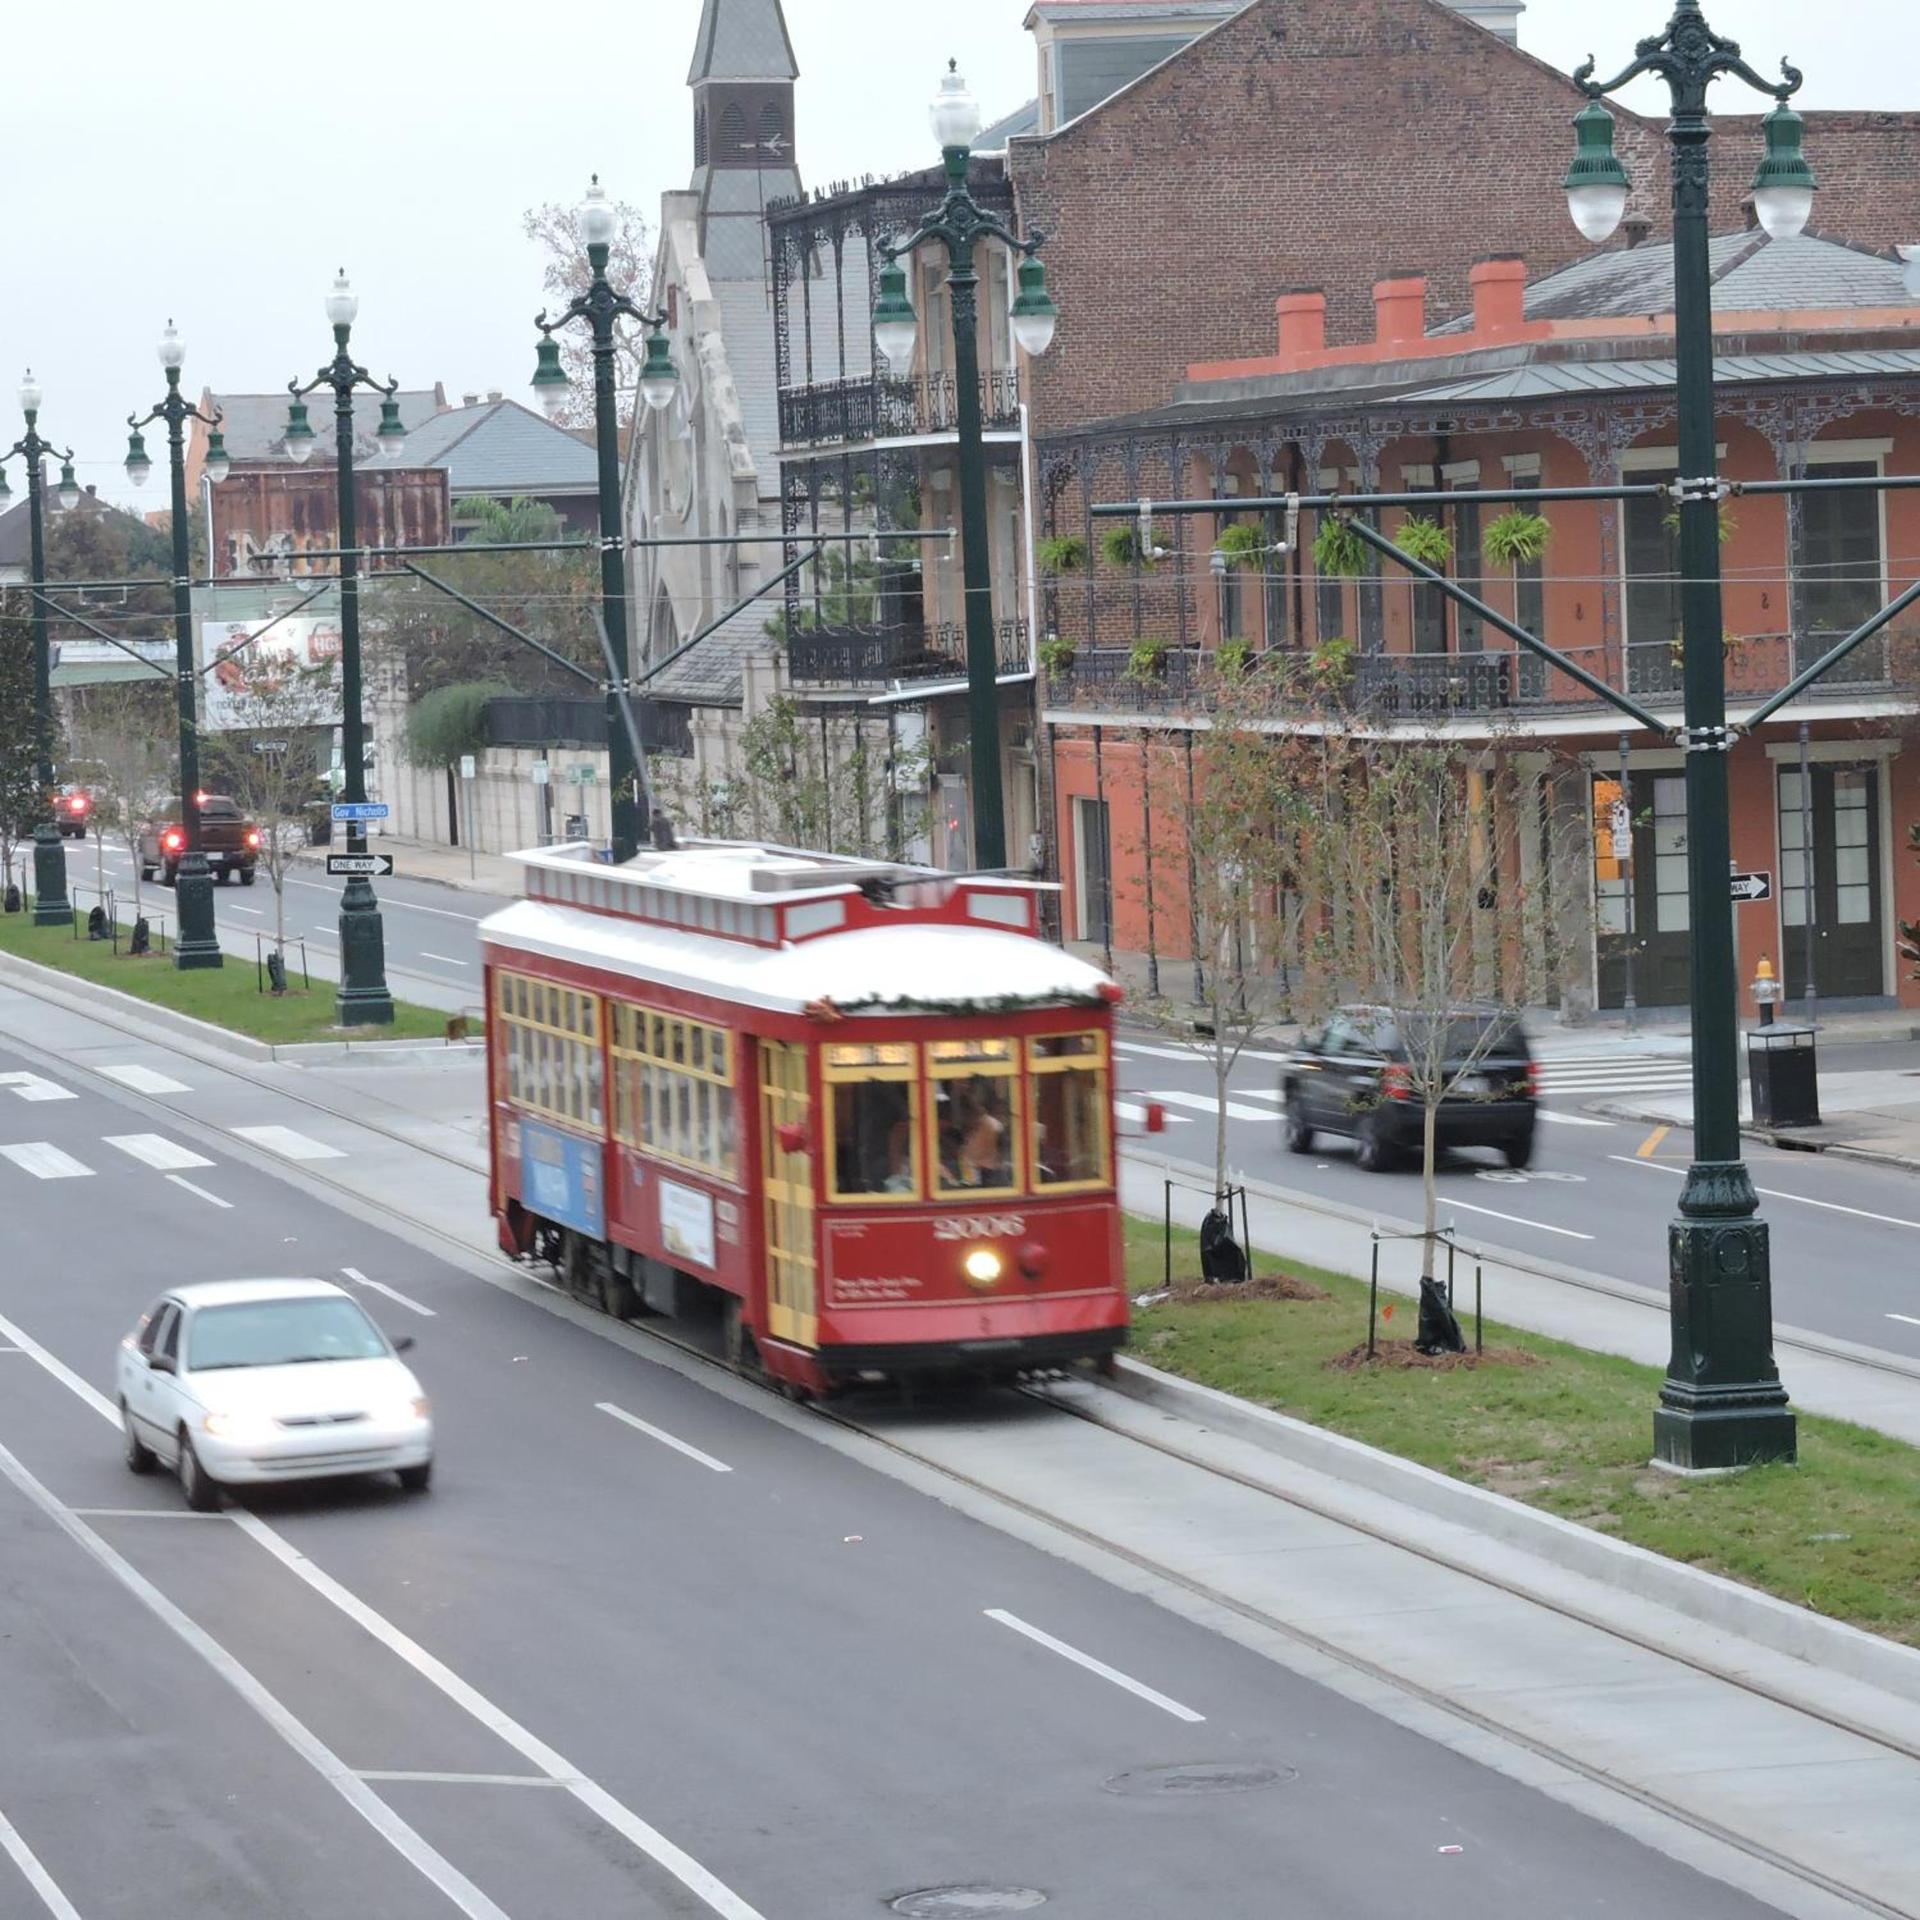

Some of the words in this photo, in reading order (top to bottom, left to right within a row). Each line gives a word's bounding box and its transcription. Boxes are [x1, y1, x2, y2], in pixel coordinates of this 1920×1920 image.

[334, 807, 350, 817] Gov
[332, 860, 351, 870] ONE
[354, 860, 373, 870] WAY
[1730, 881, 1750, 893] WAY
